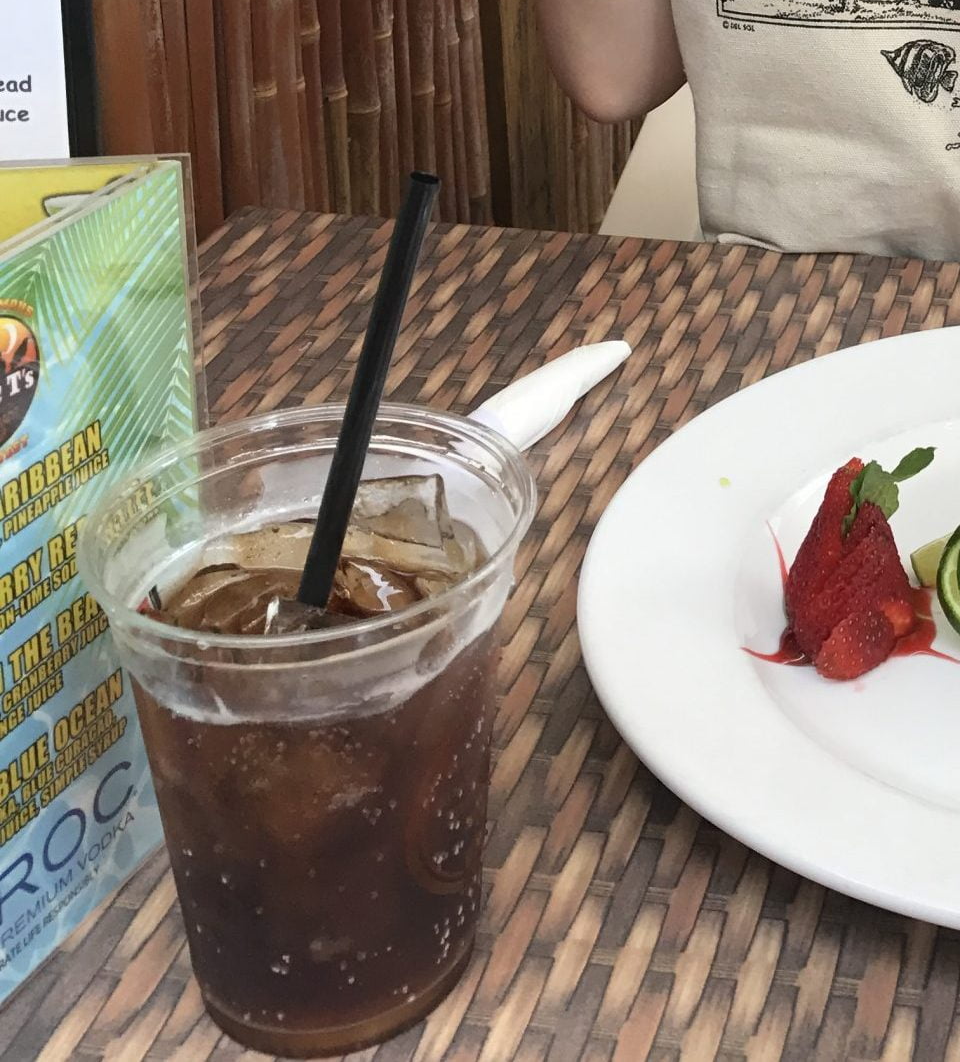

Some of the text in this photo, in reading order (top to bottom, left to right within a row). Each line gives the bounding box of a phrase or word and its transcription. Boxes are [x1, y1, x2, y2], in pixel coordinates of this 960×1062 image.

[743, 23, 755, 32] SOL
[7, 368, 34, 396] T's
[0, 419, 102, 519] RIBBEAN
[3, 474, 74, 541] PINEAPPLE
[73, 449, 109, 489] JUICE
[2, 635, 79, 714] CRANBERRY
[8, 623, 53, 684] THE
[26, 670, 64, 717] JUICE
[0, 667, 124, 803] BLUE OCEAN
[21, 761, 54, 805] BLUE
[40, 755, 87, 808] SIMPLE
[77, 811, 135, 870] VODKA
[23, 924, 41, 947] LIFE
